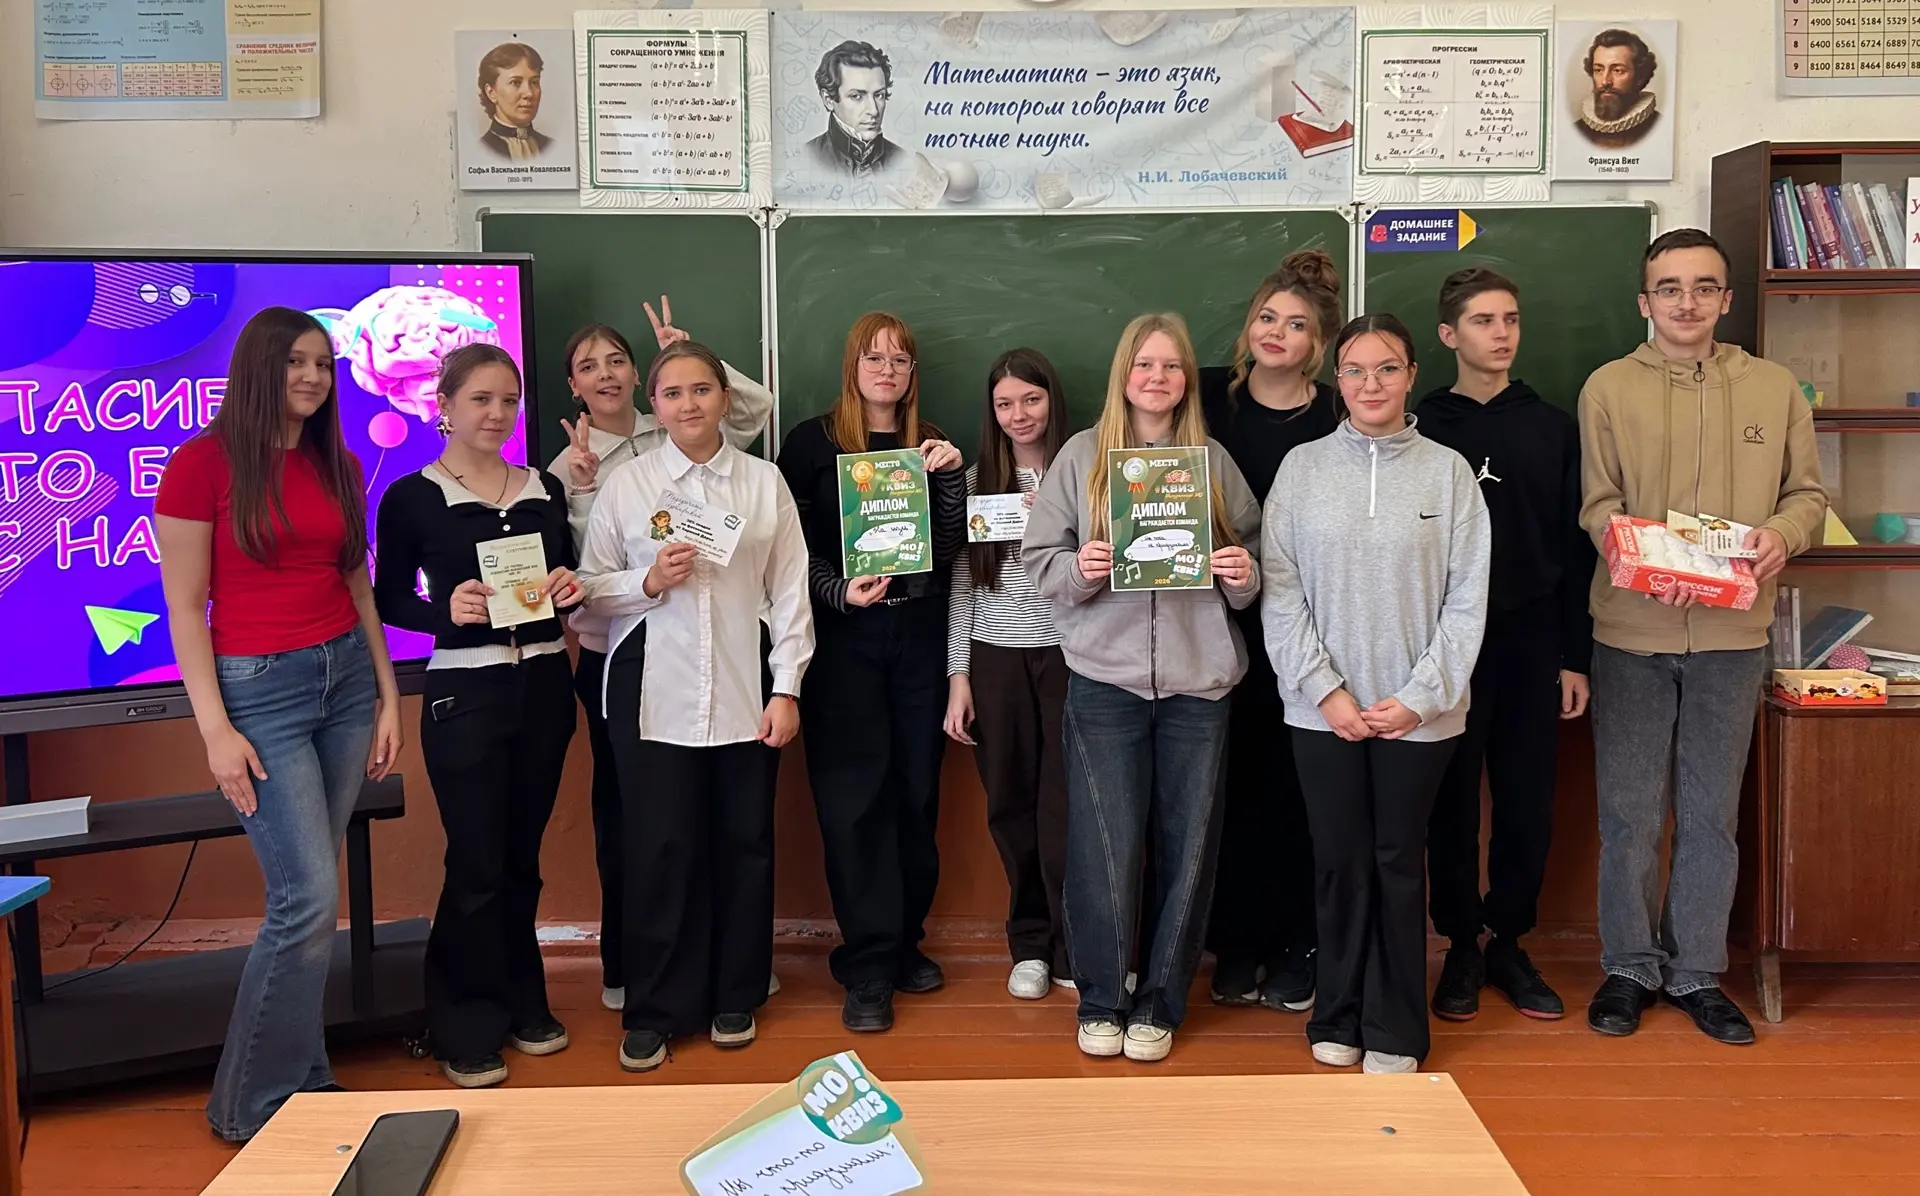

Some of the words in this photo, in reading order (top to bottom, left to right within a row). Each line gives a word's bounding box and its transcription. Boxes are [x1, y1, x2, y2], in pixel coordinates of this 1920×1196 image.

[1860, 62, 1881, 70] 8464
[923, 61, 1088, 85] Математика
[1116, 66, 1161, 83] это
[1166, 66, 1222, 91] язык,
[924, 102, 952, 116] на
[960, 100, 1065, 124] котором
[1071, 91, 1165, 124] говорят
[1174, 89, 1210, 114] все
[925, 130, 1010, 149] точные
[1017, 131, 1090, 157] науки.
[1588, 156, 1620, 167] Франсуа
[1622, 156, 1639, 166] Виет
[1138, 172, 1173, 183] Н.И.
[1178, 168, 1288, 183] Лобачевский
[1390, 219, 1454, 231] ДОМАШНЕЕ
[1397, 232, 1447, 243] ЗАДАНИЕ
[875, 460, 900, 469] МЕСТО
[1149, 459, 1179, 468] МЕСТО
[860, 498, 909, 516] ДИПЛОМ
[1131, 502, 1187, 520] ДИПЛОМ
[1173, 564, 1200, 576] КВИЗ
[827, 1091, 888, 1140] КВИЗ
